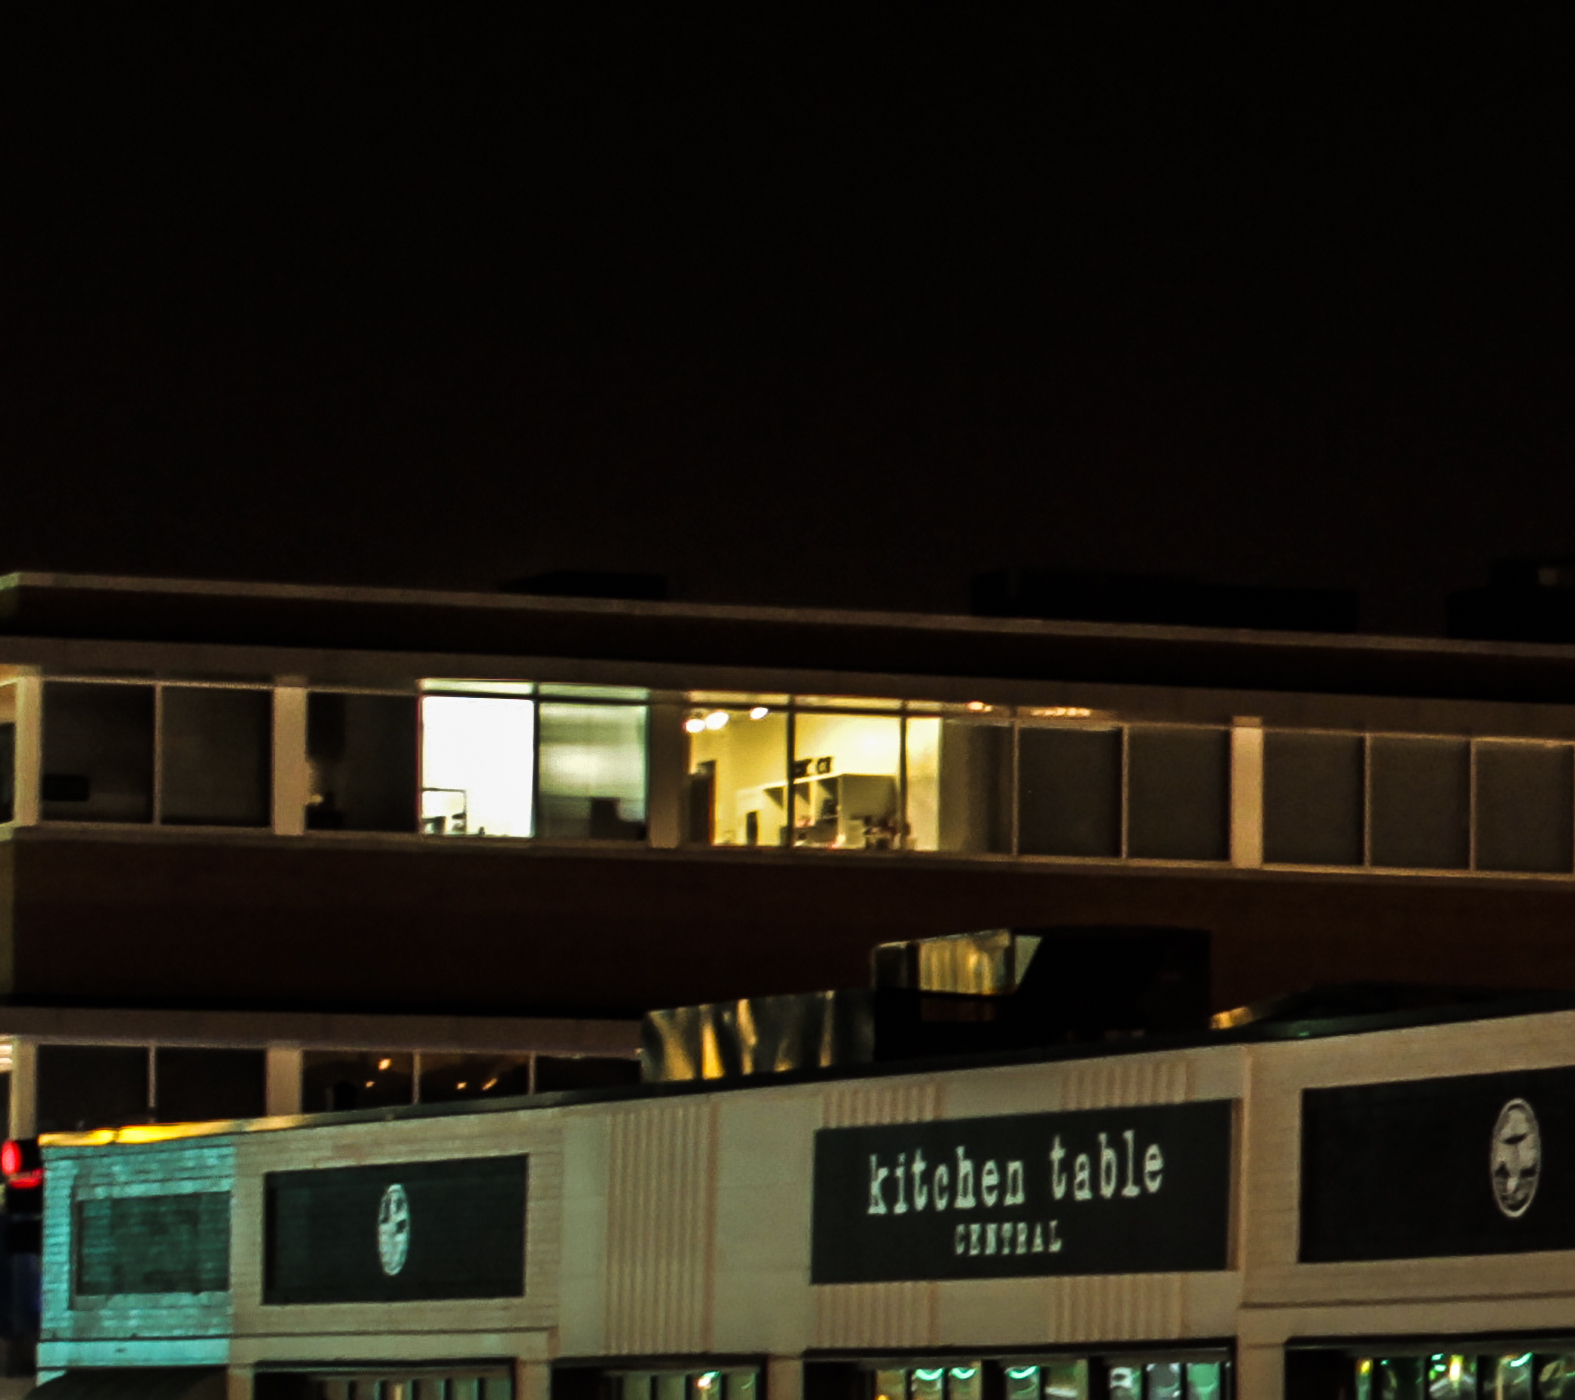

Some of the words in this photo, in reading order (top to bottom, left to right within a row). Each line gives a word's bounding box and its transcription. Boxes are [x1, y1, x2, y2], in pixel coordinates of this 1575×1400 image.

[867, 1145, 1026, 1214] kitchen
[1050, 1129, 1164, 1202] table
[954, 1220, 1063, 1256] CENTRAL
